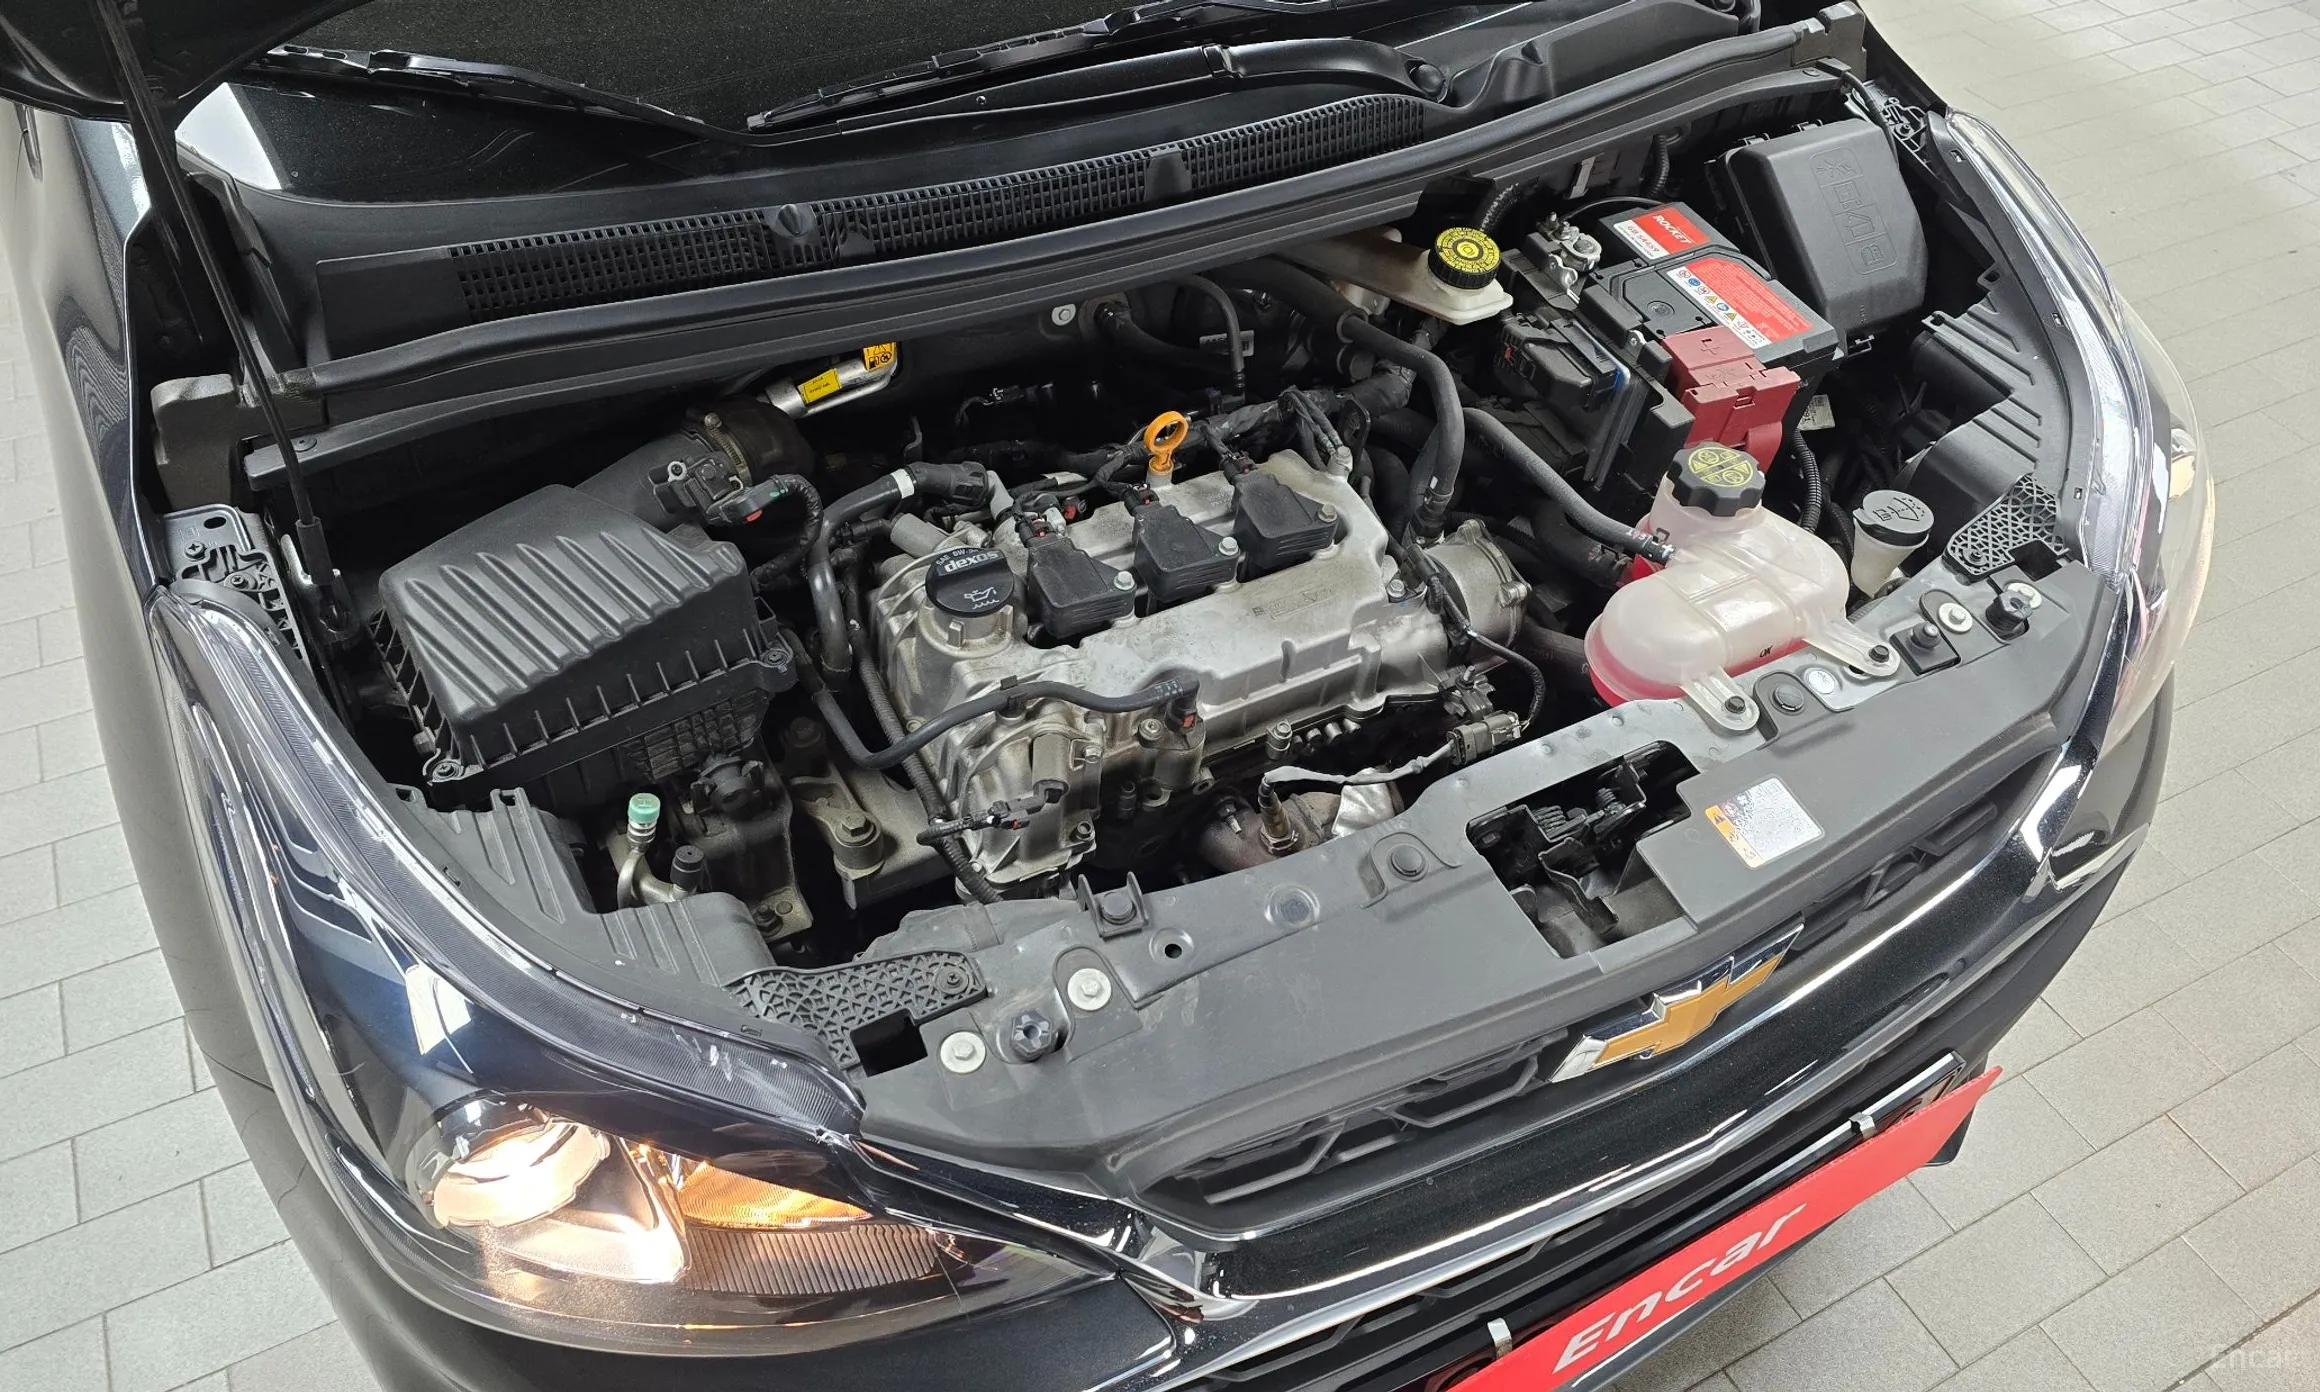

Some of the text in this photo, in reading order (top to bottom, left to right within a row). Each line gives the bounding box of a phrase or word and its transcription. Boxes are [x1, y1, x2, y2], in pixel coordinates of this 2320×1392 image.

[1653, 215, 1693, 243] ROCKET
[936, 554, 951, 566] SAE
[944, 550, 999, 572] dexos
[1552, 1203, 1807, 1374] Encar
